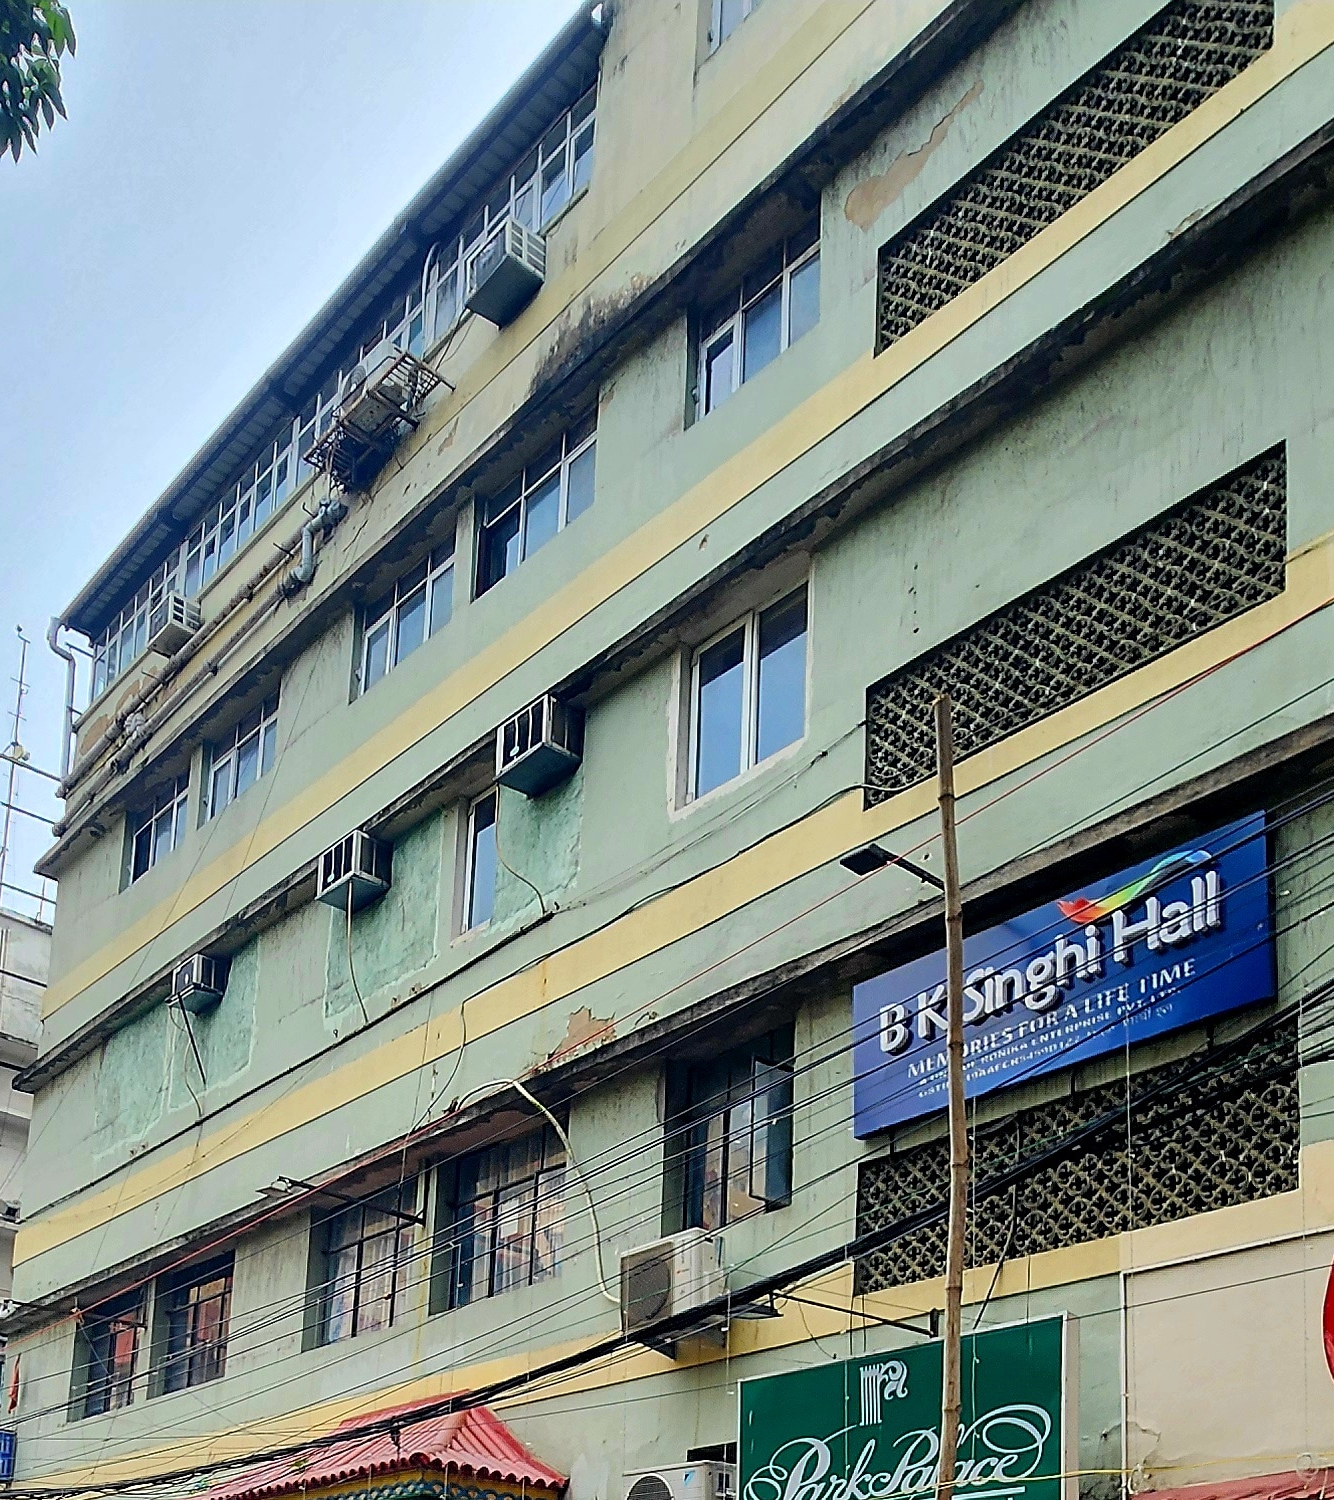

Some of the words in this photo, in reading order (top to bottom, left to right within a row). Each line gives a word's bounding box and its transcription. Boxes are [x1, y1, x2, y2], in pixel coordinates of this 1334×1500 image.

[963, 924, 1103, 1021] Singhi
[1113, 870, 1223, 963] Hall
[1018, 1011, 1058, 1038] FOR
[1084, 983, 1130, 1014] LIFE
[1139, 957, 1197, 994] TIME
[870, 1404, 1051, 1495] Paace
